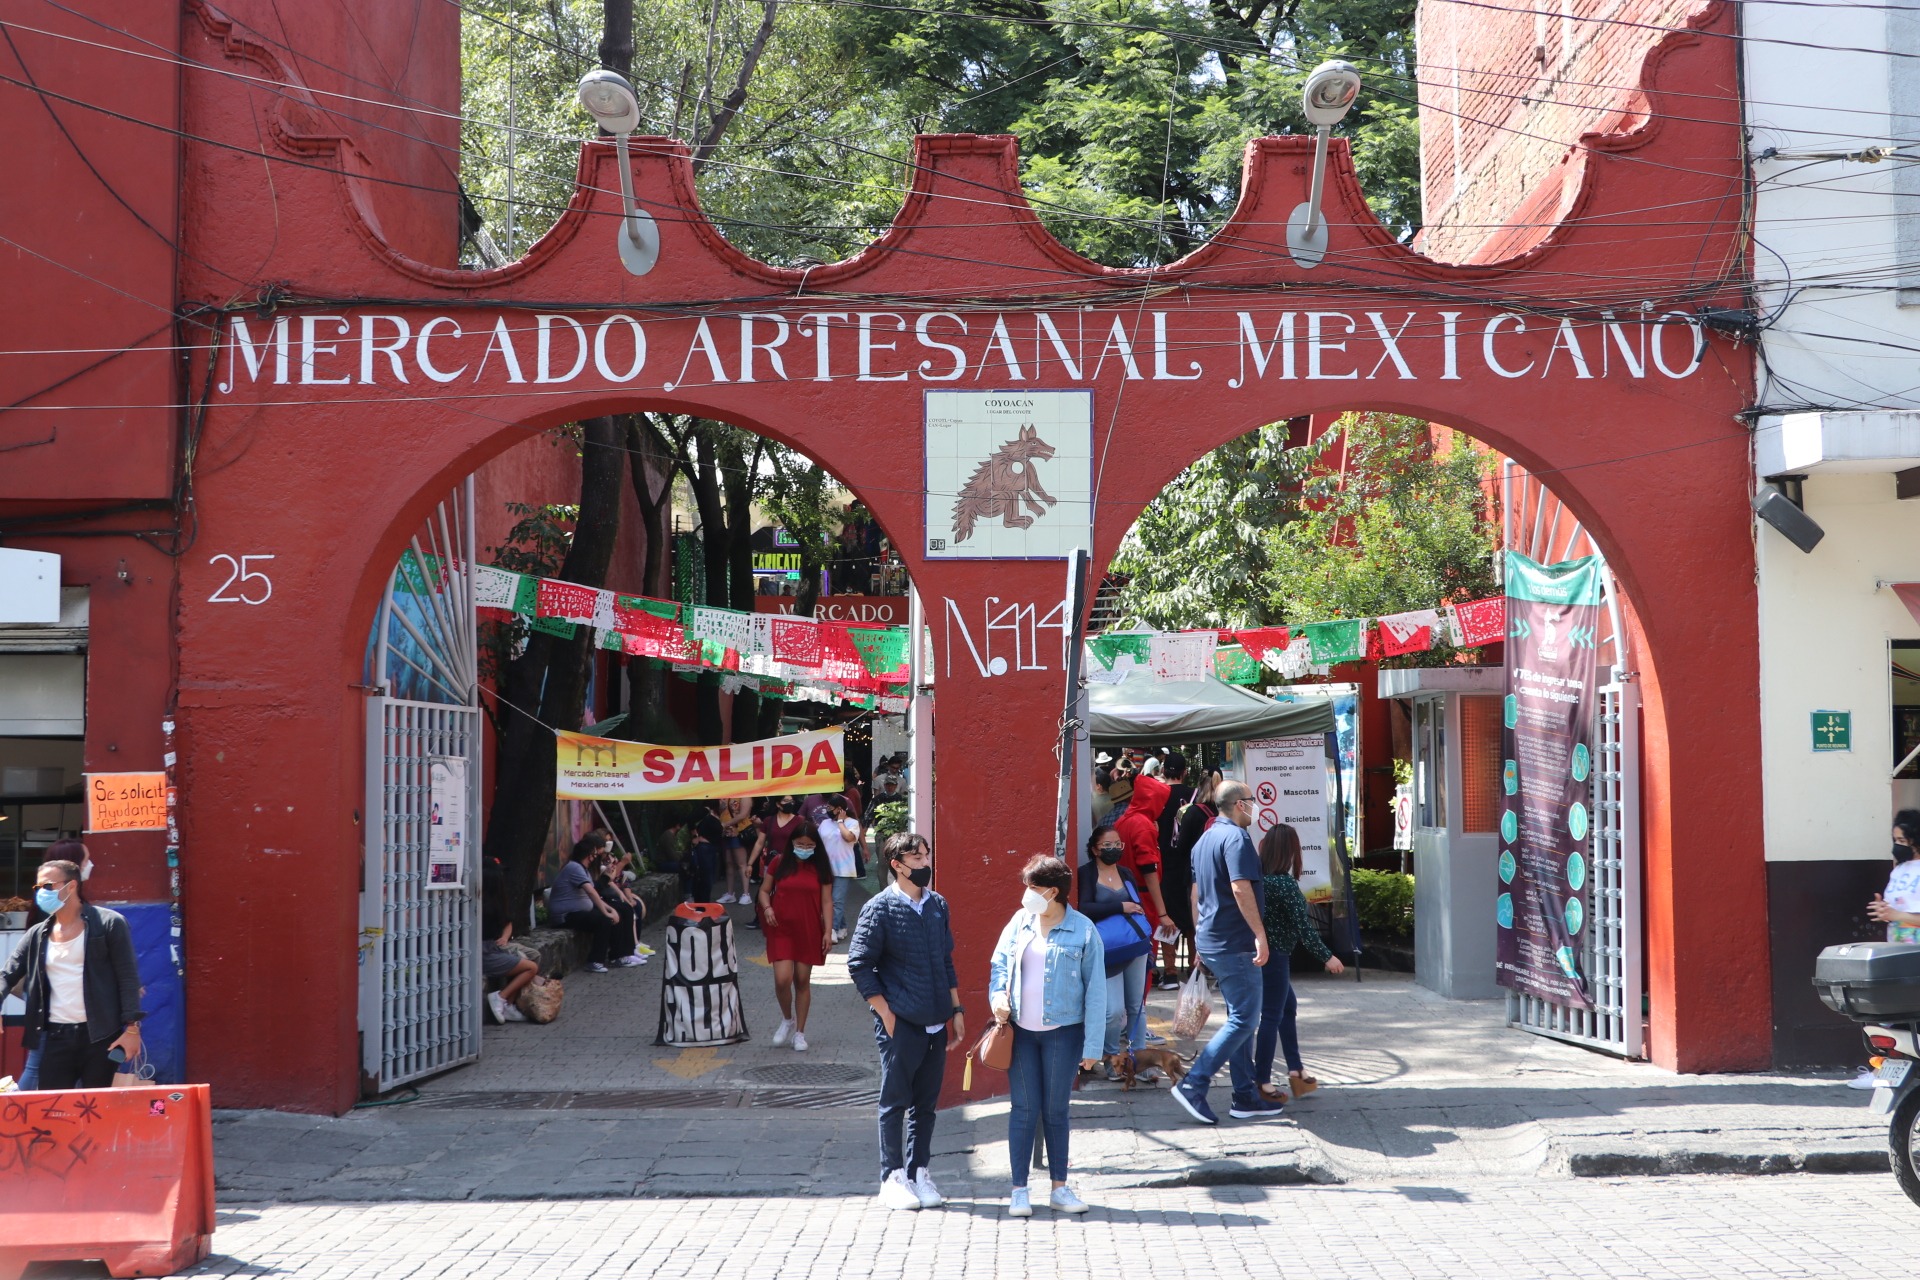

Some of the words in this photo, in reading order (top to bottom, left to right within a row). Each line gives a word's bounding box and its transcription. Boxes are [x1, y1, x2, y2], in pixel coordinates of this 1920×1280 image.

[218, 313, 647, 394] MERCADO
[661, 311, 1205, 392] ARTESANAL
[1228, 309, 1704, 391] MEXICANO
[984, 399, 1034, 407] COYOACAN
[207, 553, 277, 606] 25
[779, 603, 893, 622] MRCADO
[1245, 739, 1270, 750] Mercado
[1270, 737, 1298, 749] Artesanal
[1298, 736, 1324, 747] Mexicano
[642, 739, 842, 784] SALIDA
[1266, 750, 1304, 758] Bienvenidos
[563, 769, 595, 778] Mercado
[595, 770, 630, 779] Artesanal
[95, 779, 116, 802] Se
[1283, 788, 1320, 796] Mascotas
[101, 815, 161, 830] General
[1284, 815, 1321, 823] Bicicletas
[665, 919, 738, 982] SOLO
